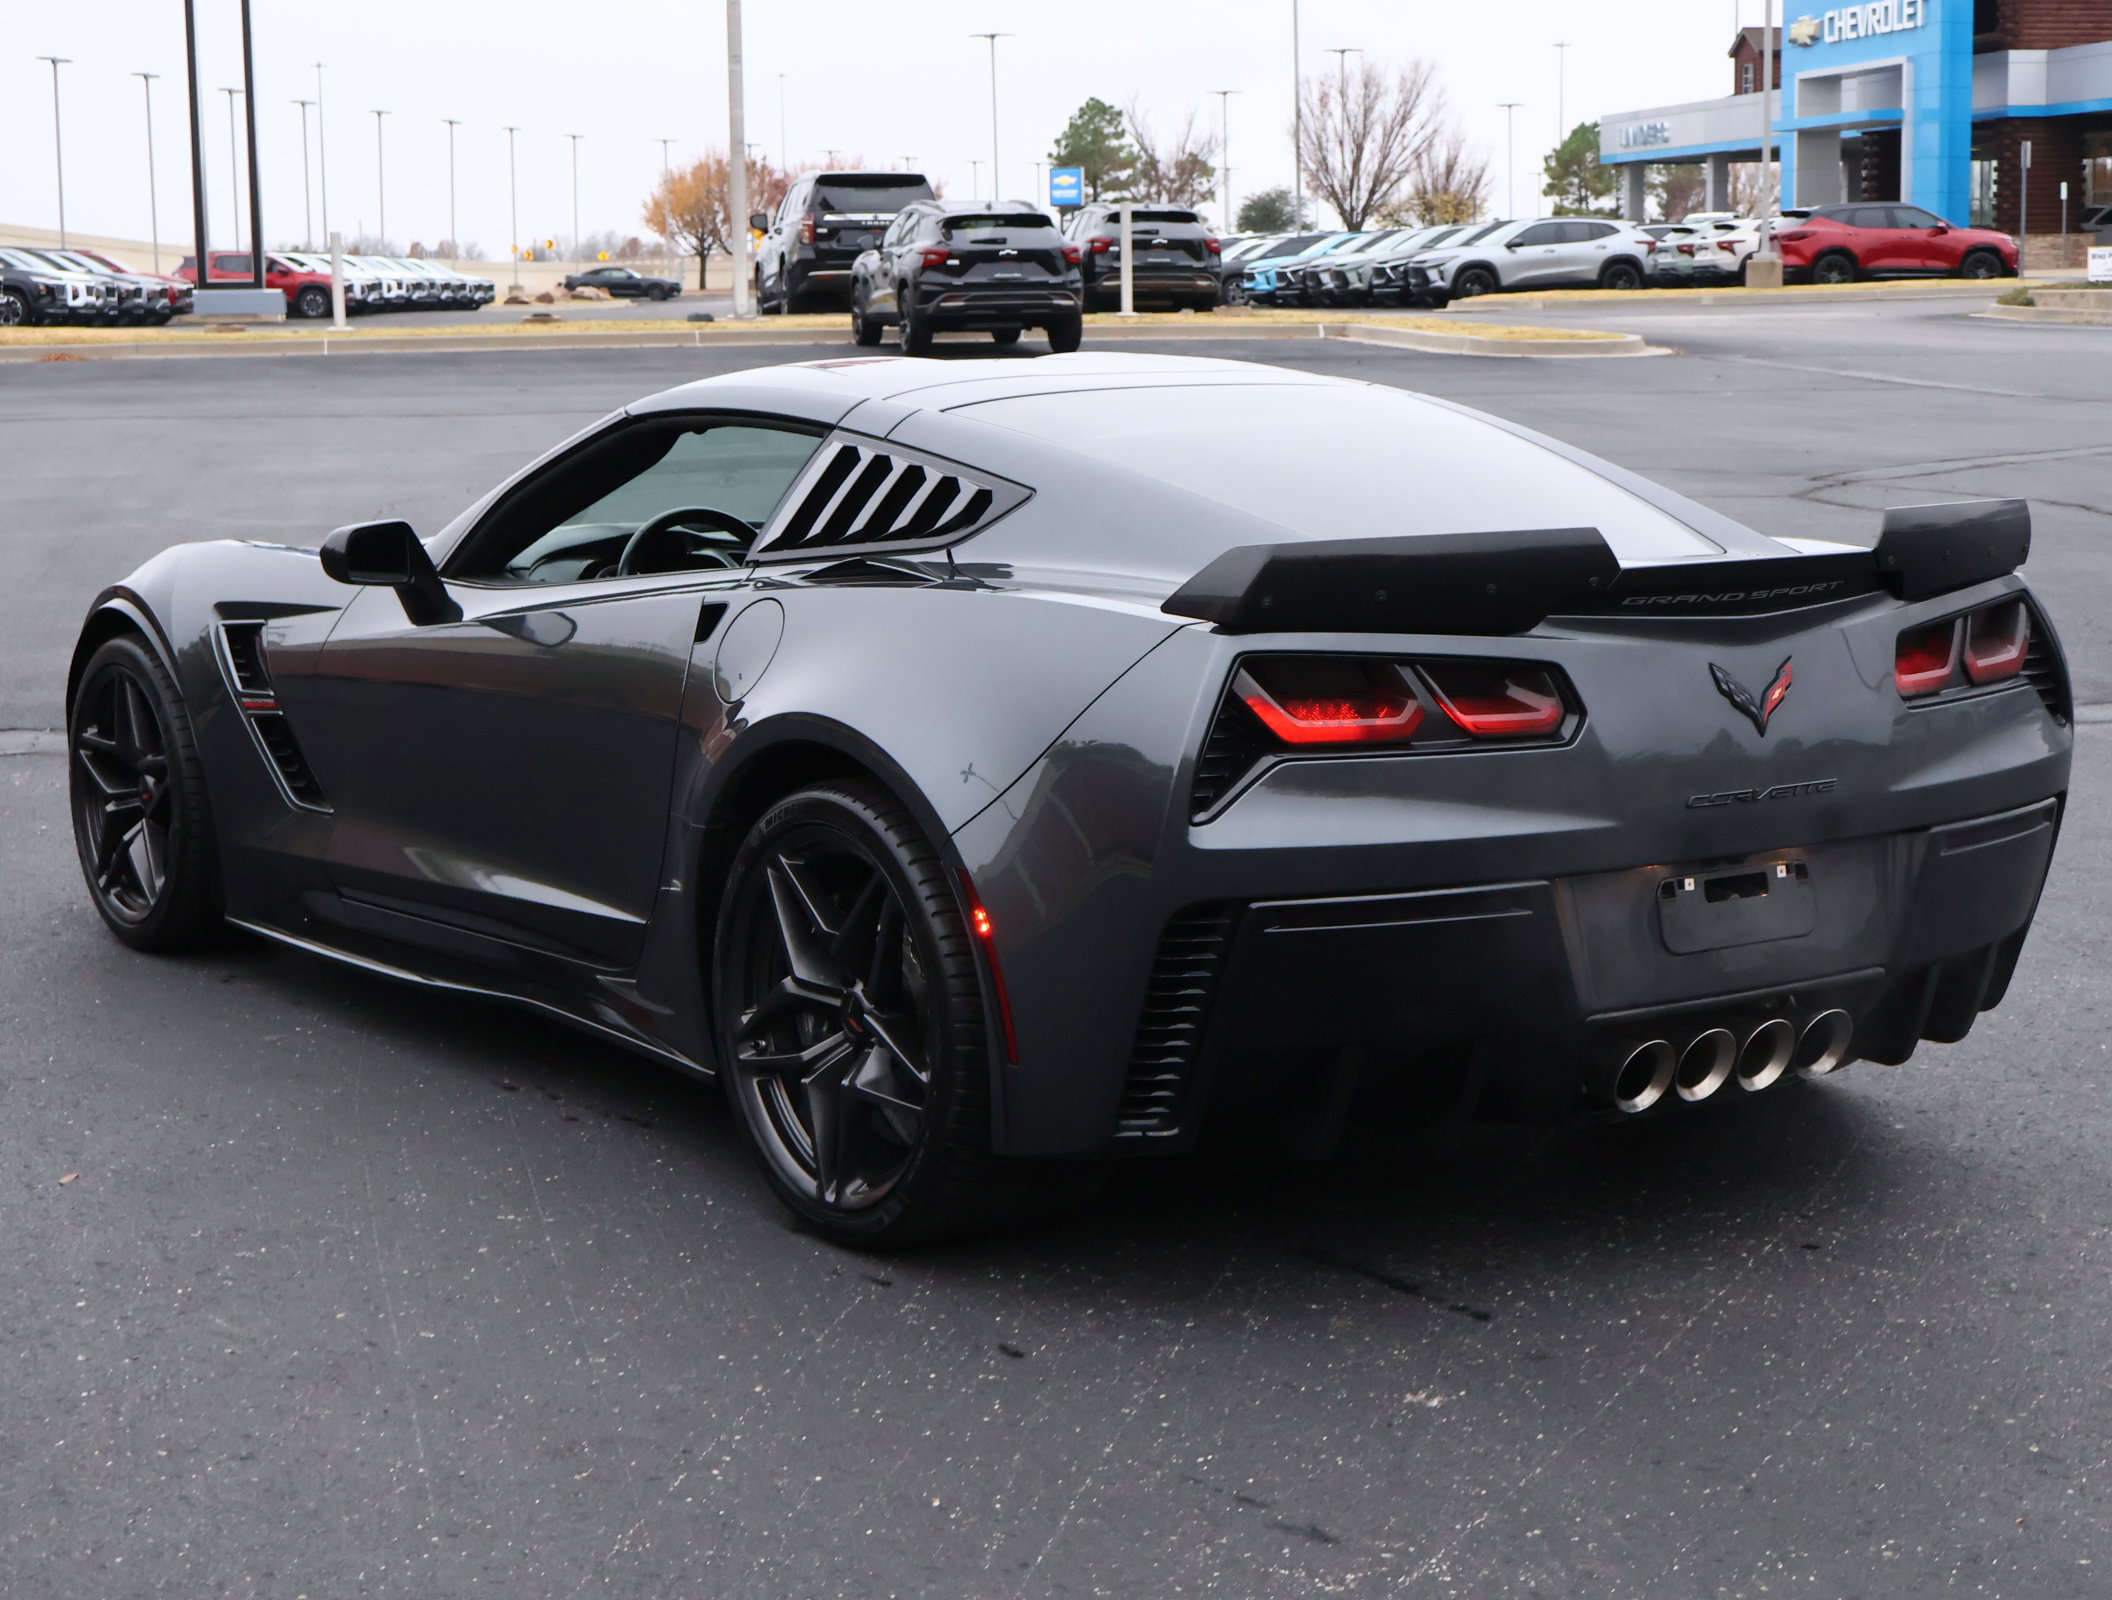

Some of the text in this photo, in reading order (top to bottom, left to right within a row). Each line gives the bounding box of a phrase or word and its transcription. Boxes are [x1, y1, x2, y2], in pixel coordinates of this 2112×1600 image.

[1823, 0, 1926, 43] CHEVROLET
[1622, 580, 1845, 606] GRAND SPORT
[1685, 777, 1838, 808] CORVETTE
